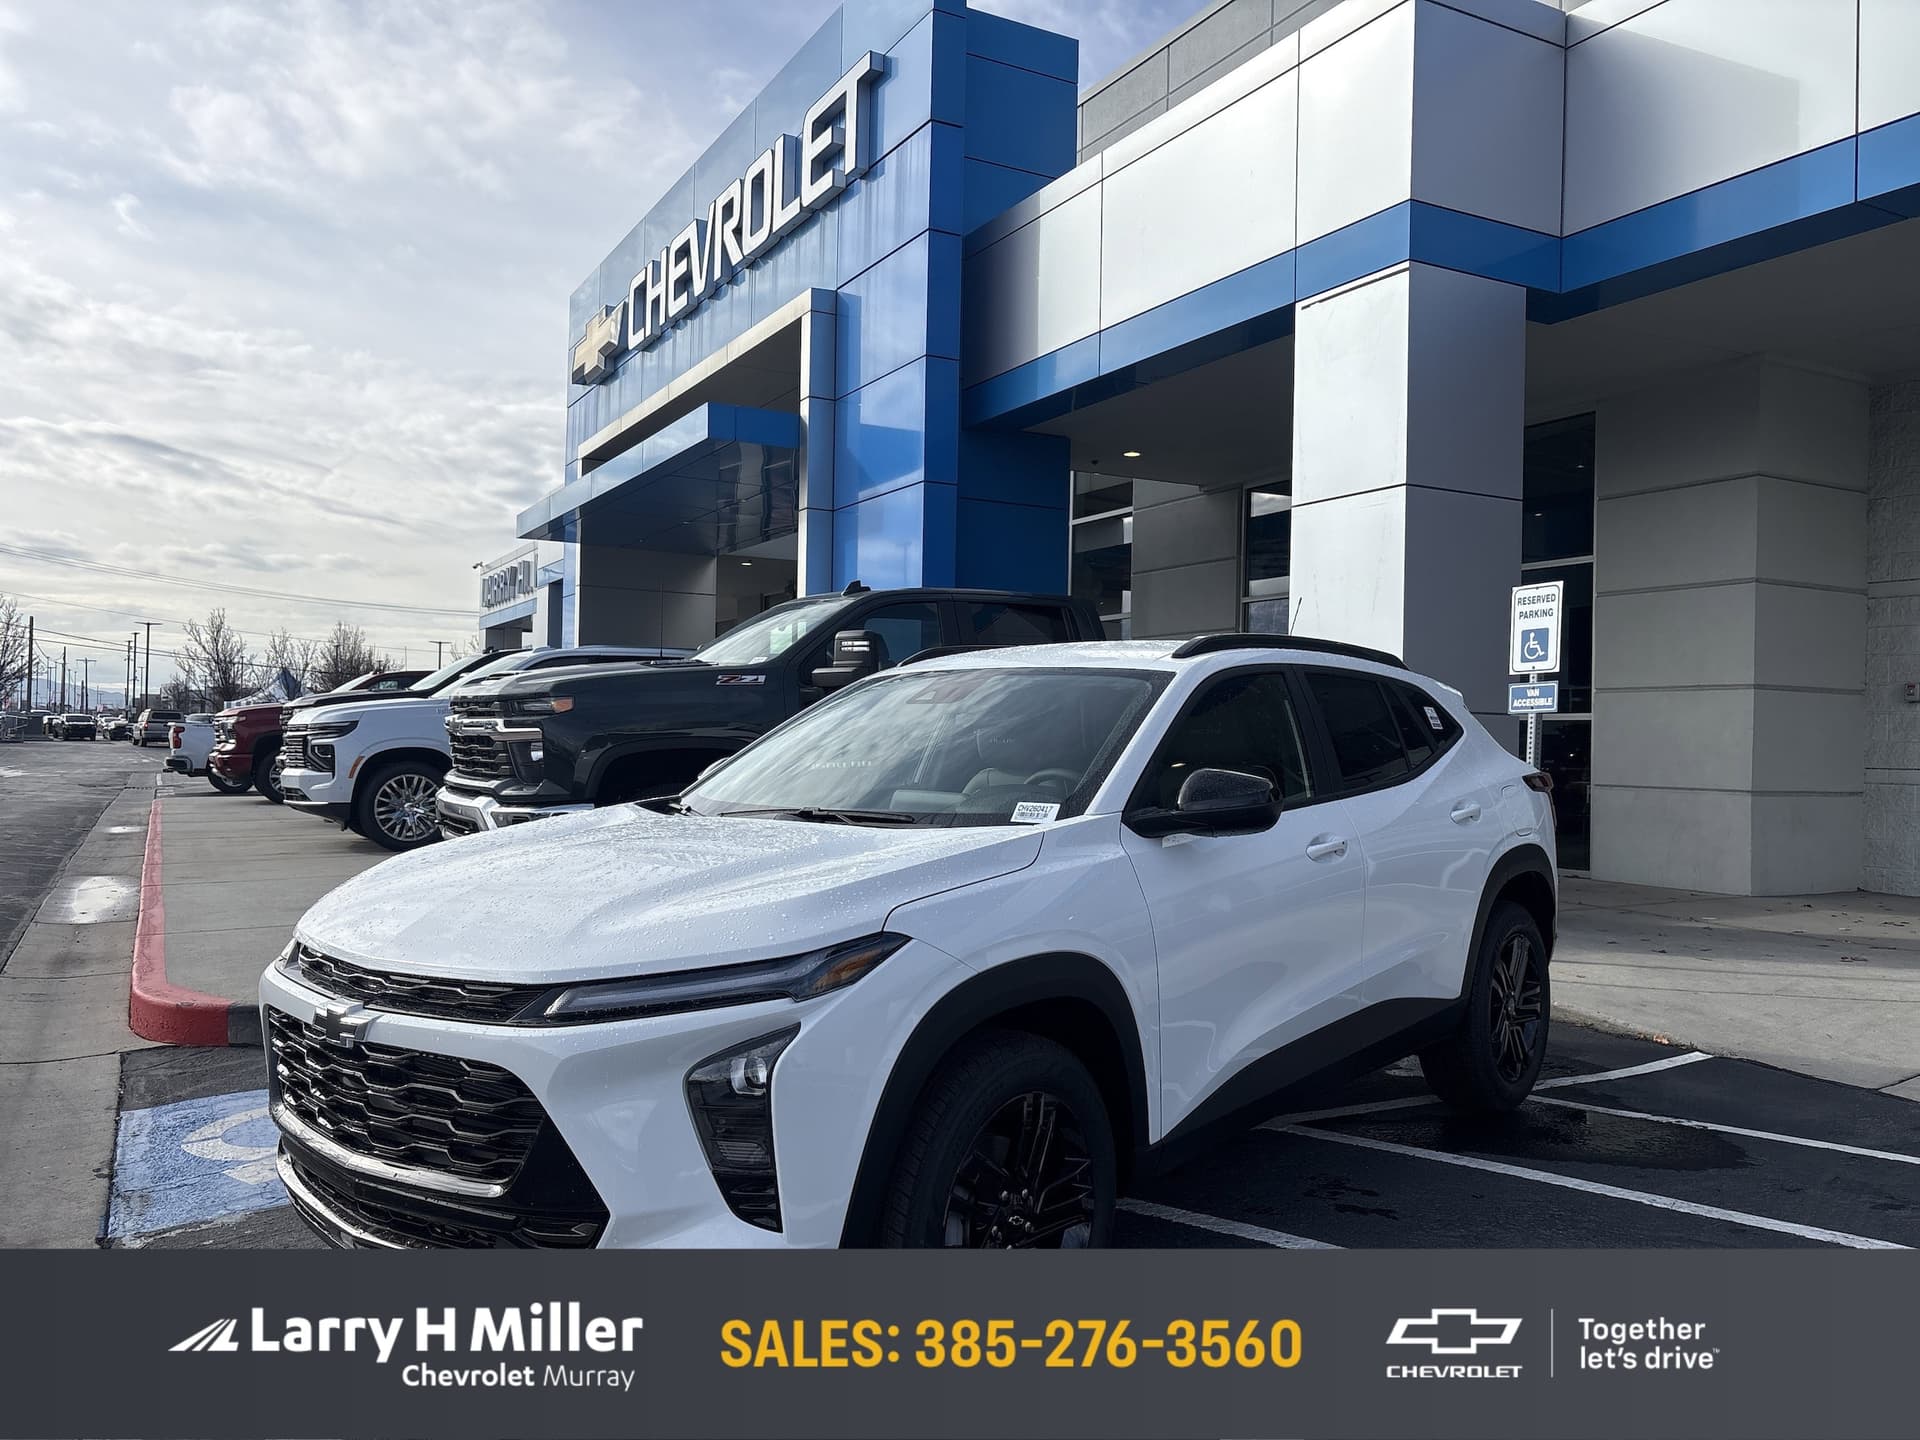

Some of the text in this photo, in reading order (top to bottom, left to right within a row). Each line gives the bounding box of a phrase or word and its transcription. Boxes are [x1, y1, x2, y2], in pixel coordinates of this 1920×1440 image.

[627, 50, 876, 351] CHEVROLET
[482, 565, 518, 607] LARRY
[1517, 593, 1557, 606] RESERVED
[1519, 607, 1554, 620] PARKING
[716, 674, 766, 686] Z71
[1526, 687, 1540, 697] VAN
[1513, 697, 1553, 707] ACCESSIBLE
